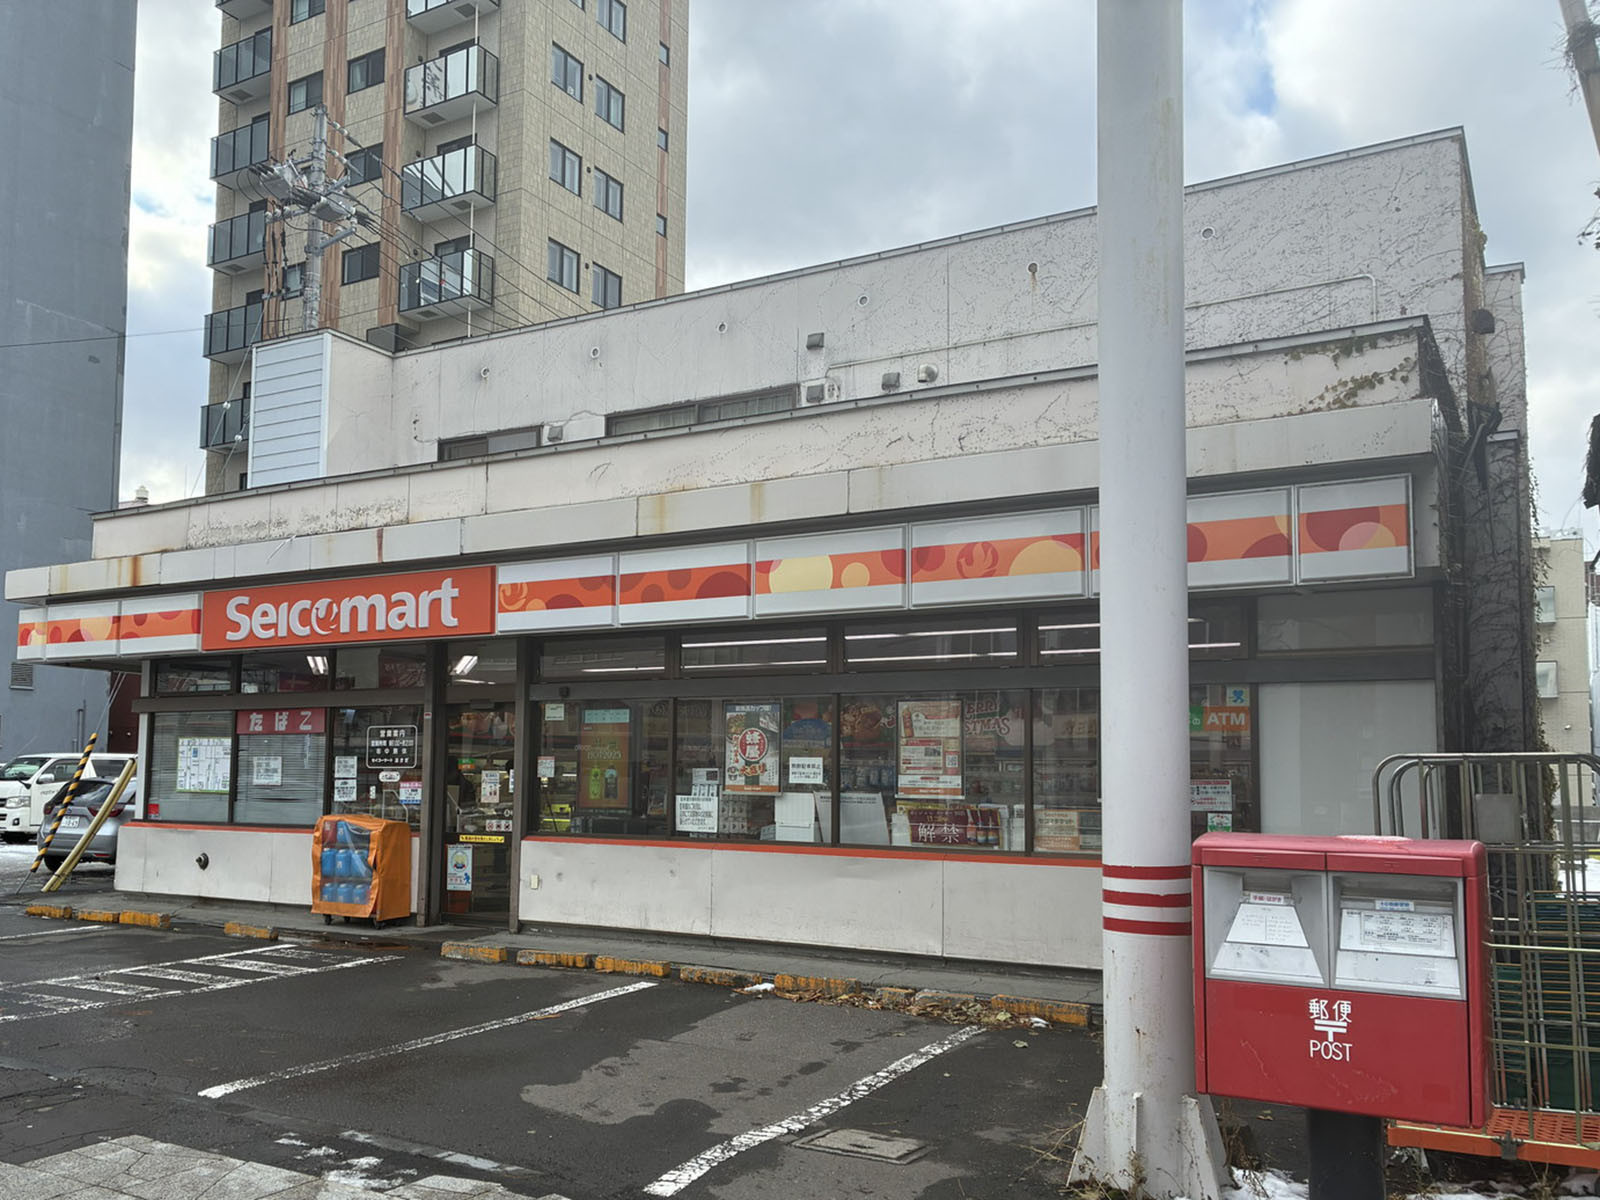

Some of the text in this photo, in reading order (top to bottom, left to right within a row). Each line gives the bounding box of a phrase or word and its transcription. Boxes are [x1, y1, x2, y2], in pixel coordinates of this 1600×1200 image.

[225, 577, 459, 641] Seicomart
[1207, 712, 1246, 726] ATM
[918, 823, 960, 844] 解禁
[1308, 998, 1353, 1023] 郵便
[1309, 1039, 1353, 1062] POST
